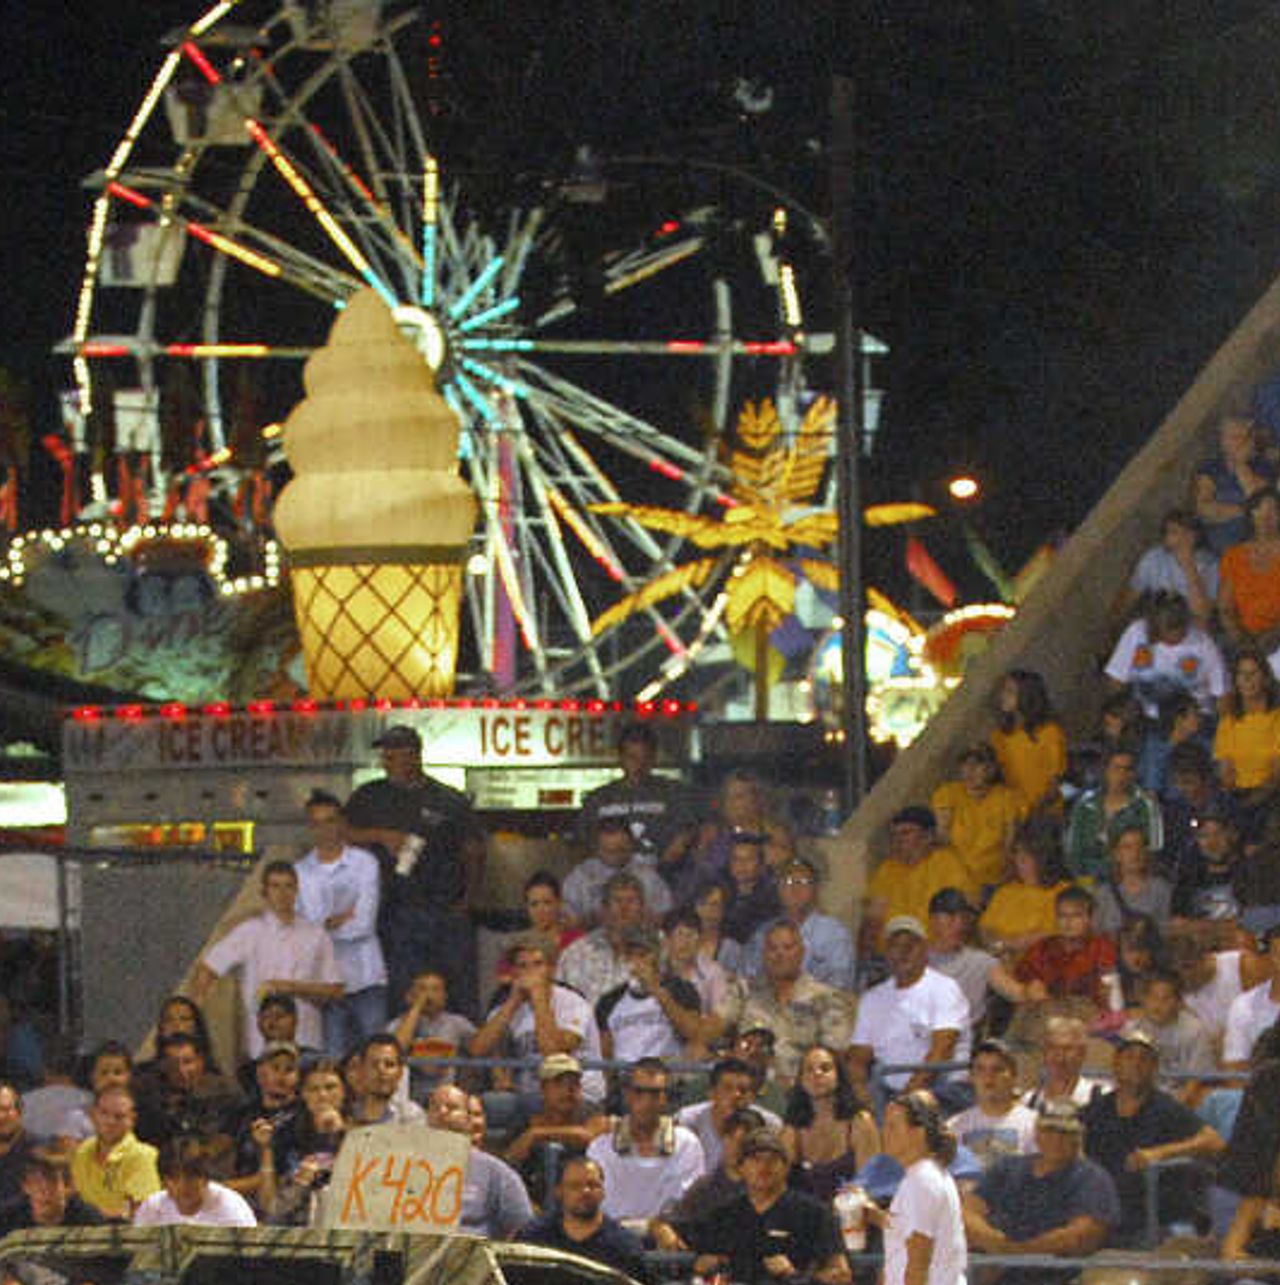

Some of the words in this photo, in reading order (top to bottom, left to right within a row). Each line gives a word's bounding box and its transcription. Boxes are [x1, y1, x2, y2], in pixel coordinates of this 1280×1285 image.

[159, 719, 202, 760] ICE
[480, 716, 531, 756] ICE
[544, 715, 619, 756] CRE
[340, 1151, 464, 1226] K420
